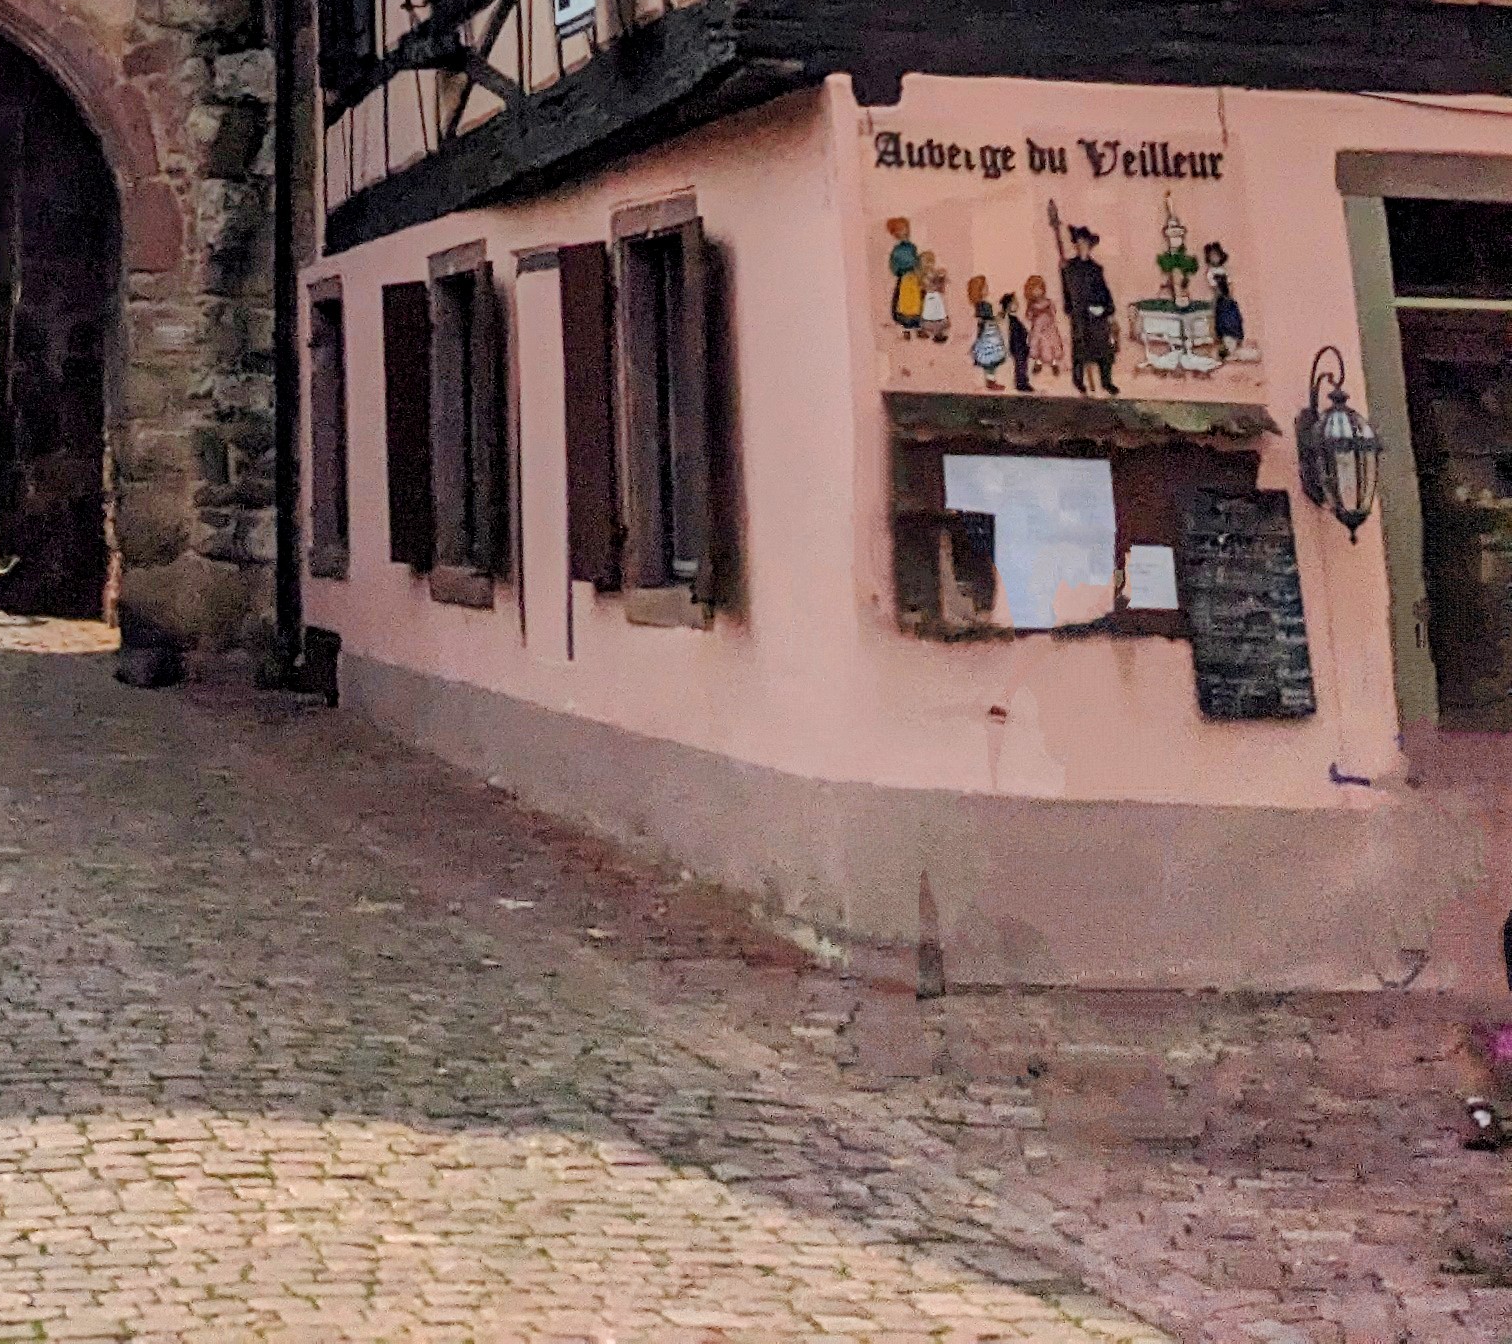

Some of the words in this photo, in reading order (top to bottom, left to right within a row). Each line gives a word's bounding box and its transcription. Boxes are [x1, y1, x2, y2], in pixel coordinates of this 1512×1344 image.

[874, 130, 1016, 179] Auberge
[1025, 137, 1068, 174] du
[1077, 137, 1224, 179] Veilleur
